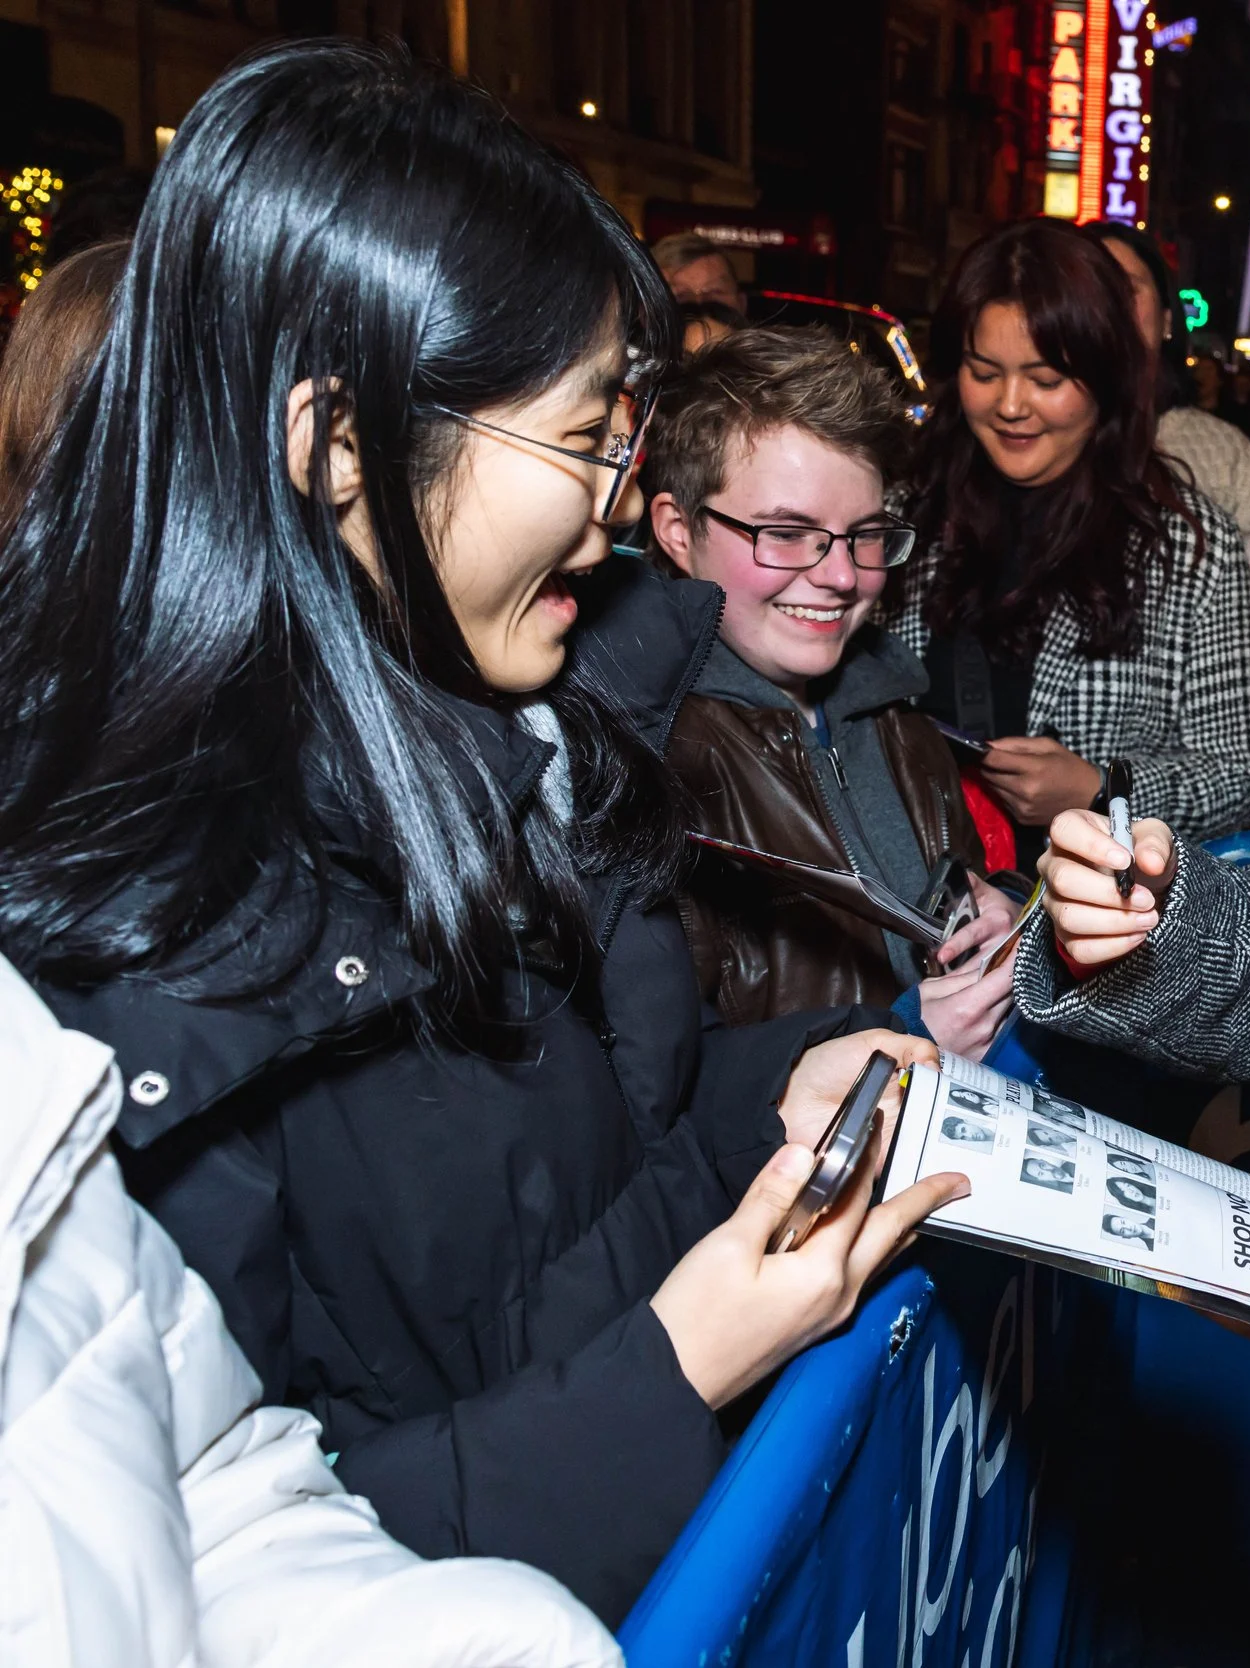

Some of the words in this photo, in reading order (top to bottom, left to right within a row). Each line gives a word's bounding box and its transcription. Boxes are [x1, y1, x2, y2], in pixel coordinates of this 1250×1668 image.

[1050, 10, 1084, 150] PARK
[1106, 0, 1147, 227] VIRGIL
[1226, 1191, 1250, 1214] NO
